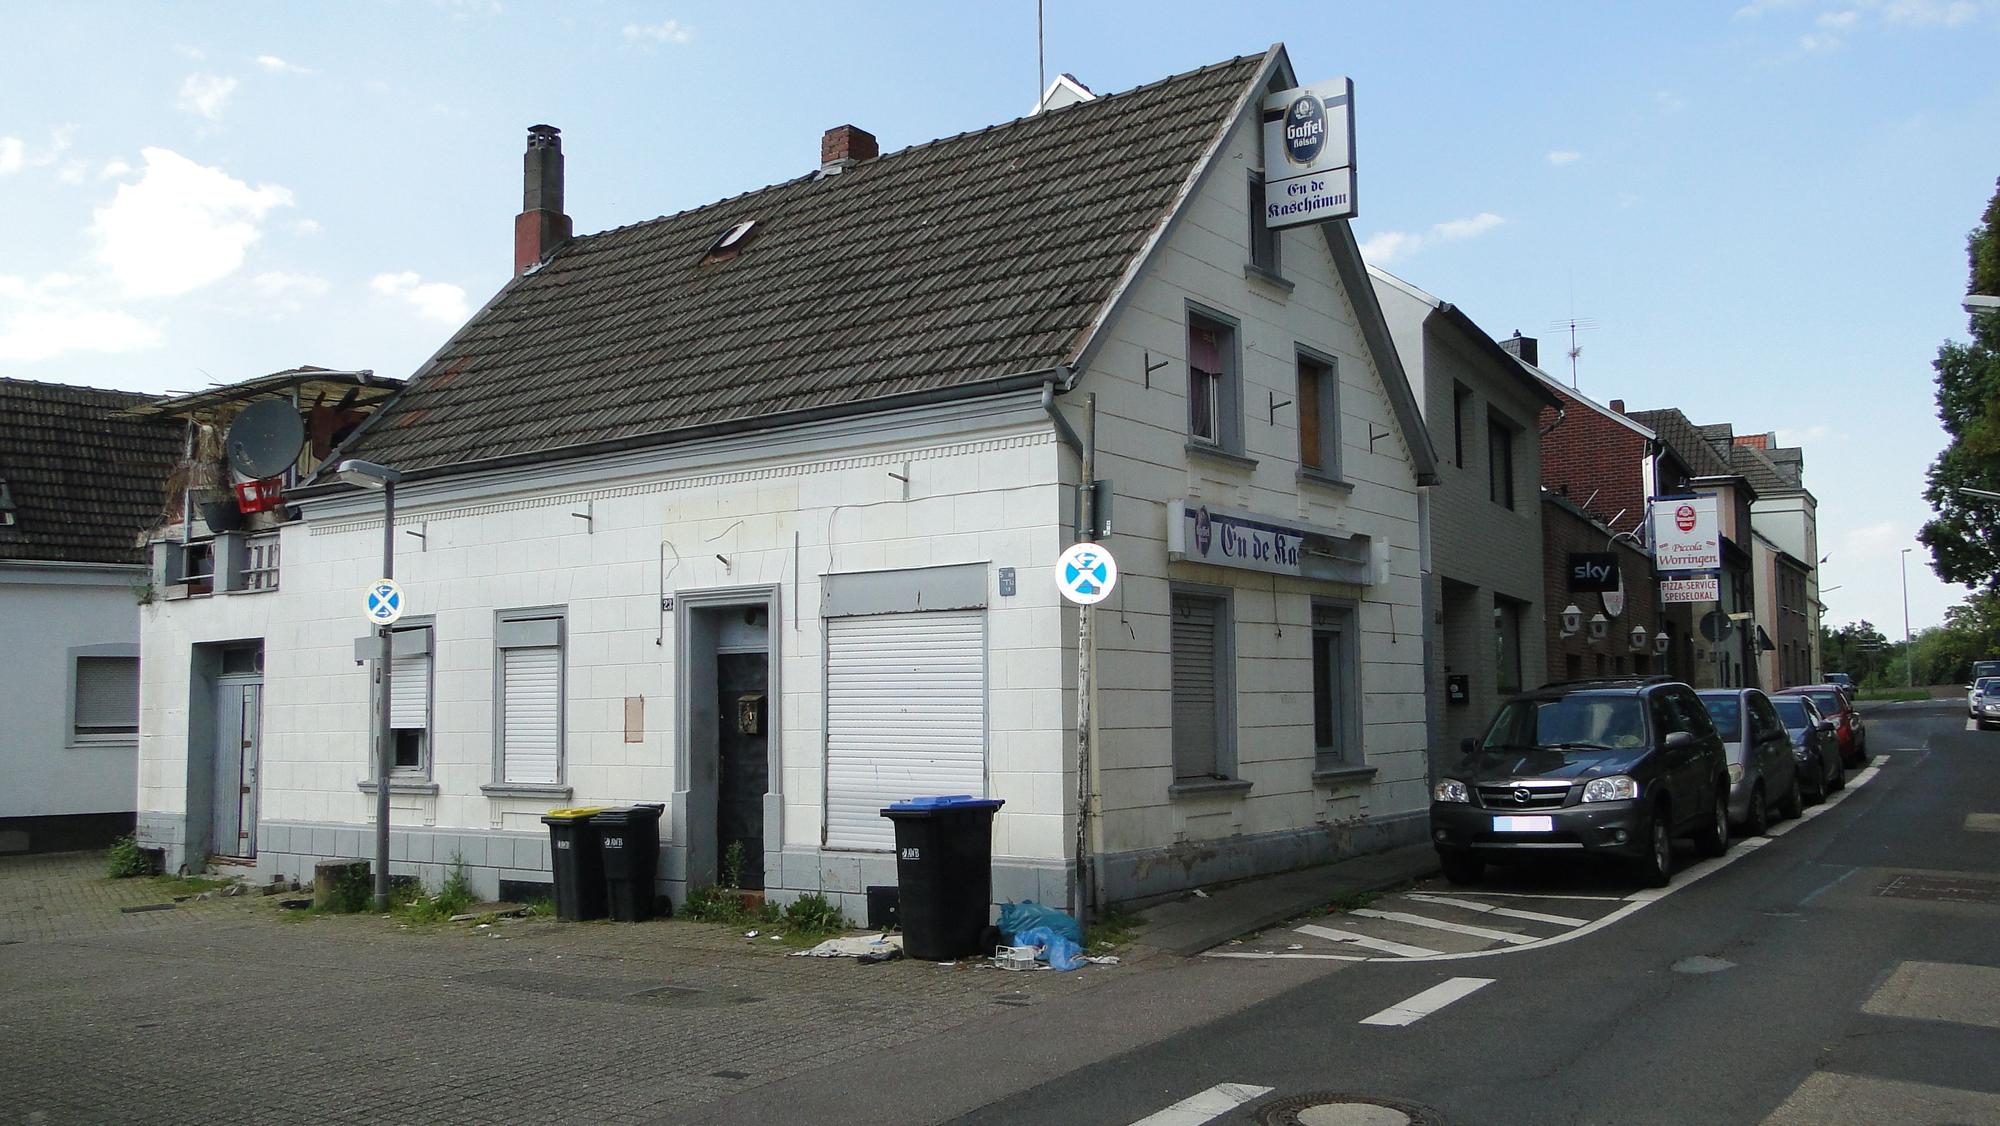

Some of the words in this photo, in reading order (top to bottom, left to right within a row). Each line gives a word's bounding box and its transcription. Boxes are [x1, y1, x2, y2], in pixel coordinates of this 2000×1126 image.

[1287, 118, 1324, 140] Gaffel
[1287, 183, 1307, 197] En
[1311, 180, 1325, 192] de
[1268, 193, 1347, 219] Kaschämm
[1252, 531, 1270, 562] de
[1659, 553, 1718, 568] Worringen
[1574, 561, 1611, 582] sky
[1661, 580, 1717, 591] PIZZA-SERVICE
[1664, 591, 1715, 601] SPEISELOKAL
